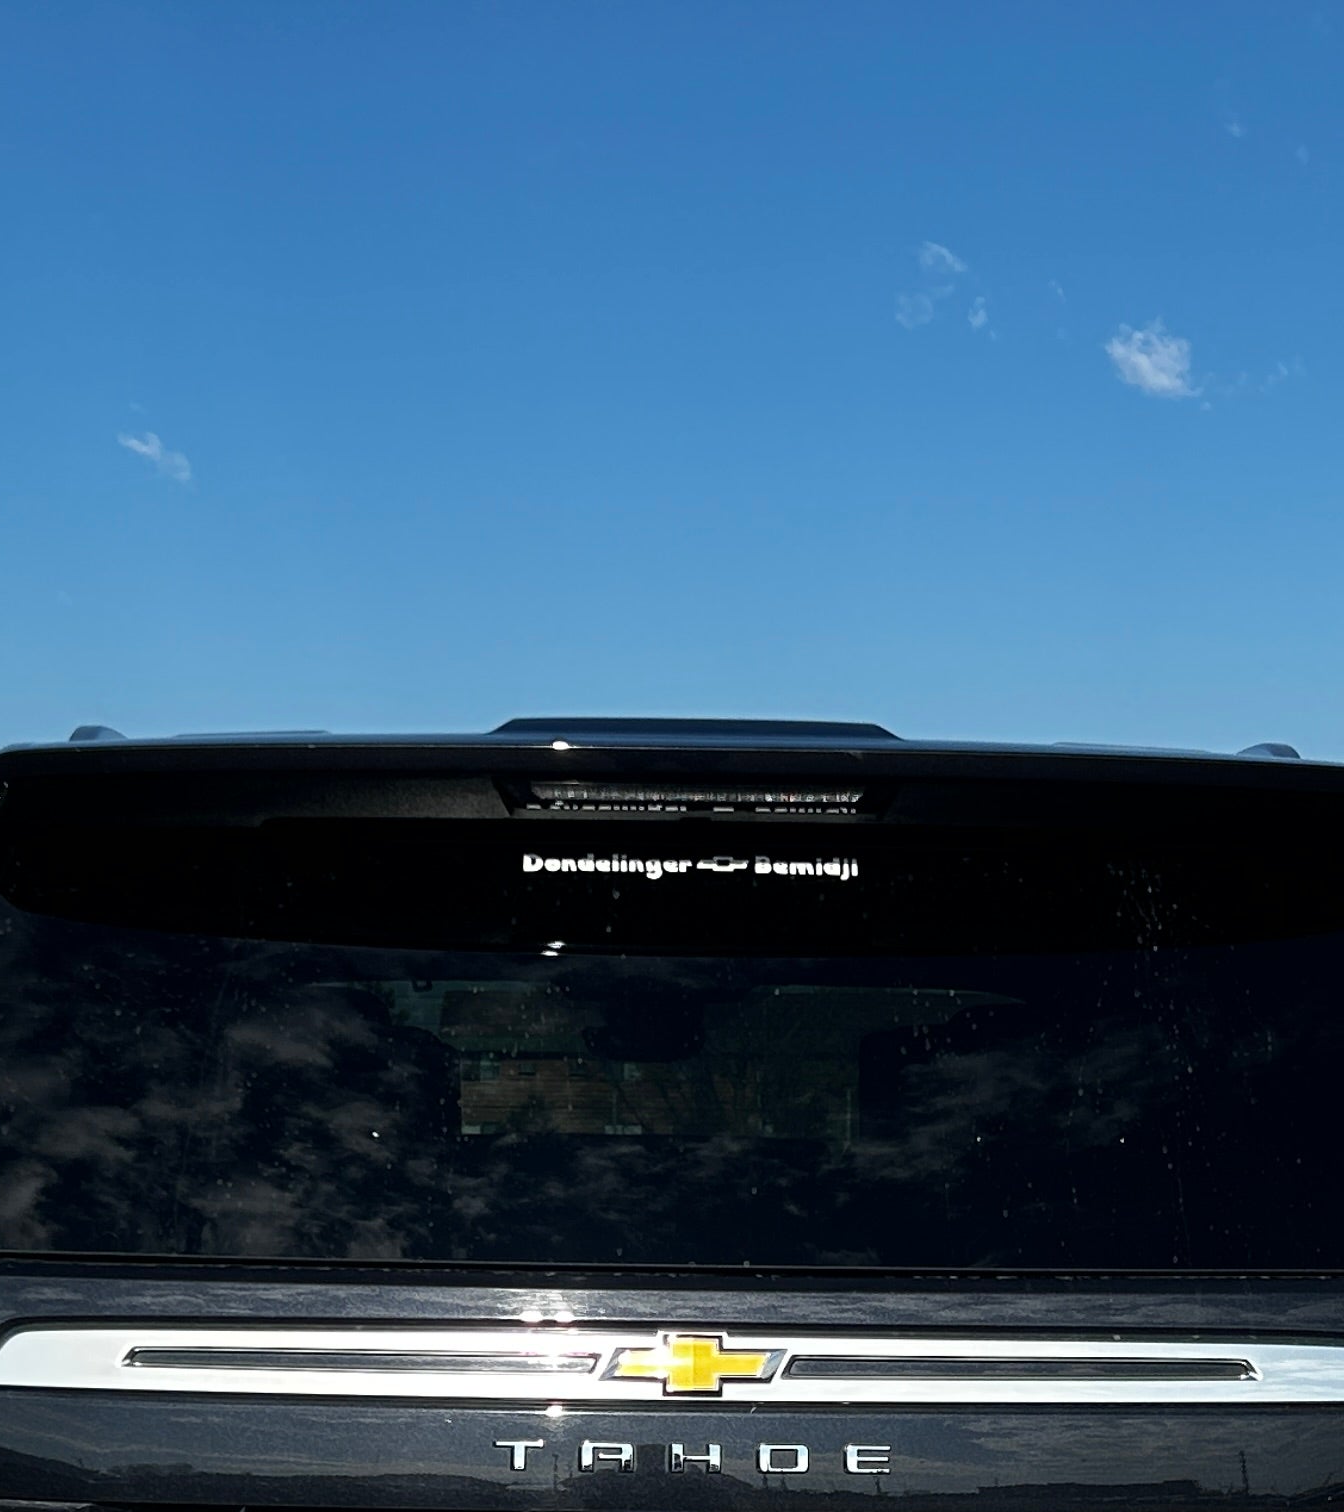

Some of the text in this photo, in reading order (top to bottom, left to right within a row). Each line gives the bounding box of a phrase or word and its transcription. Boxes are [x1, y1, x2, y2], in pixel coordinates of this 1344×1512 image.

[523, 854, 859, 880] Dondelinger Bemidji
[493, 1439, 892, 1474] TAHOE
